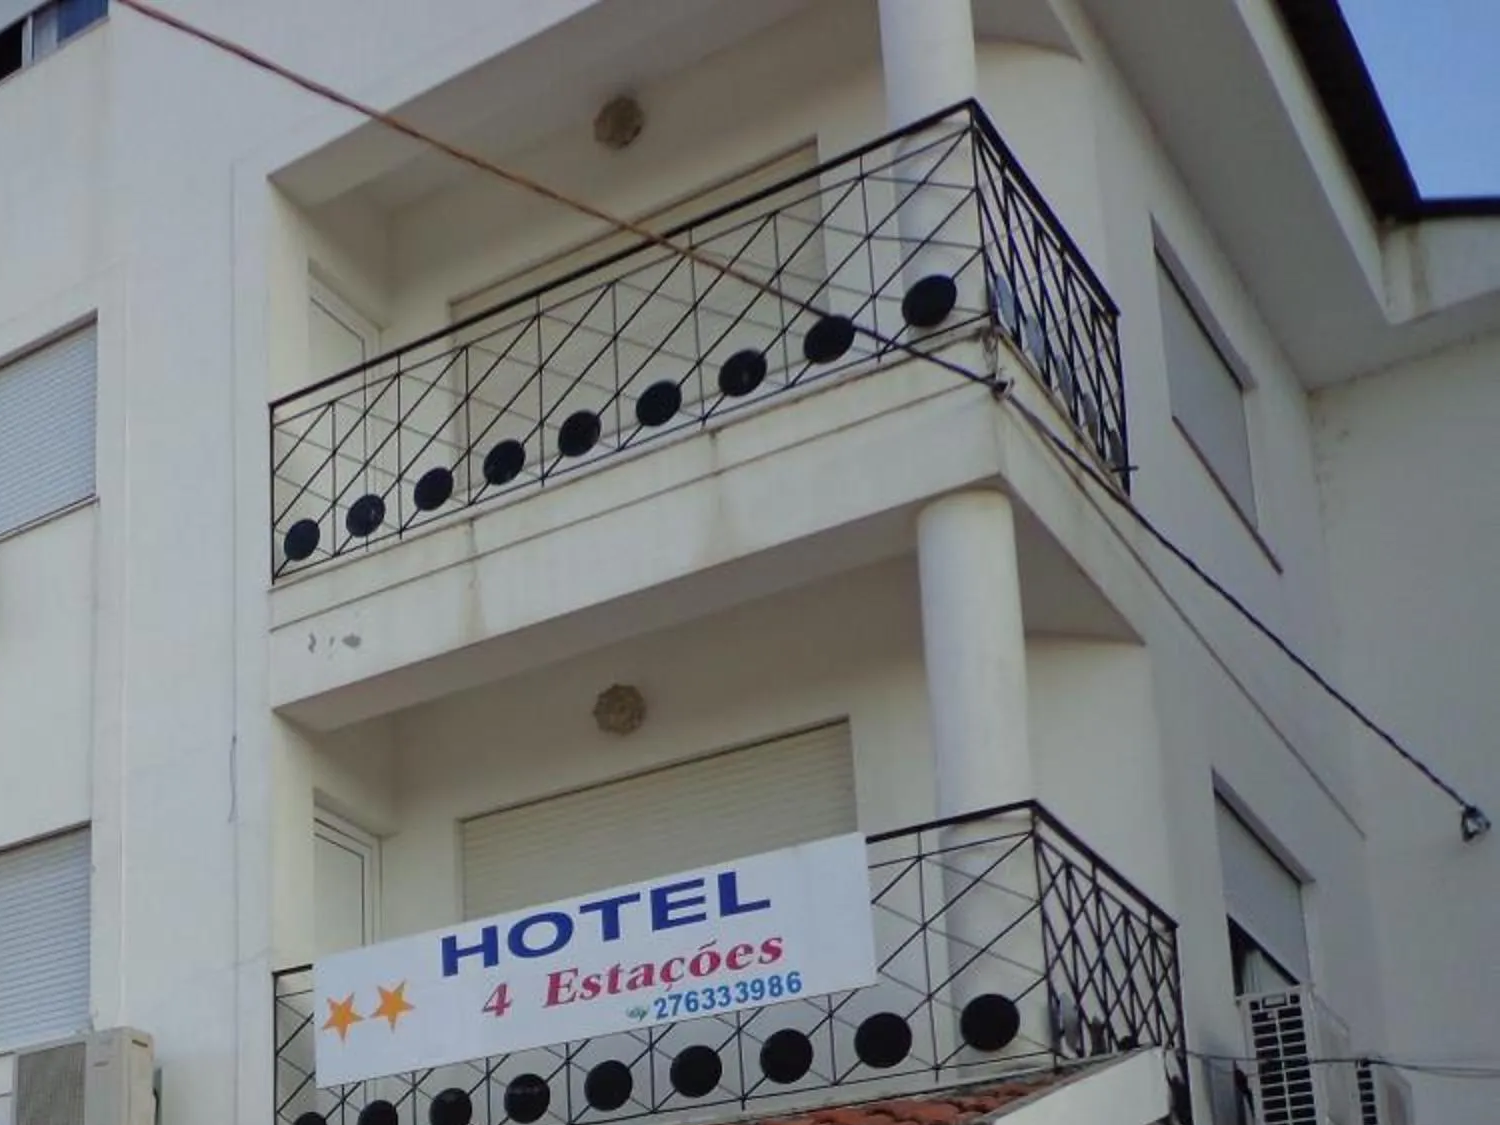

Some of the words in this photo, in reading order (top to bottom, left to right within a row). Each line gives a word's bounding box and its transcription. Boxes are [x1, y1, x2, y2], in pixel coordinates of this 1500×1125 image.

[441, 871, 771, 977] HOTEL
[482, 983, 511, 1017] 4
[653, 971, 803, 1020] 276333986
